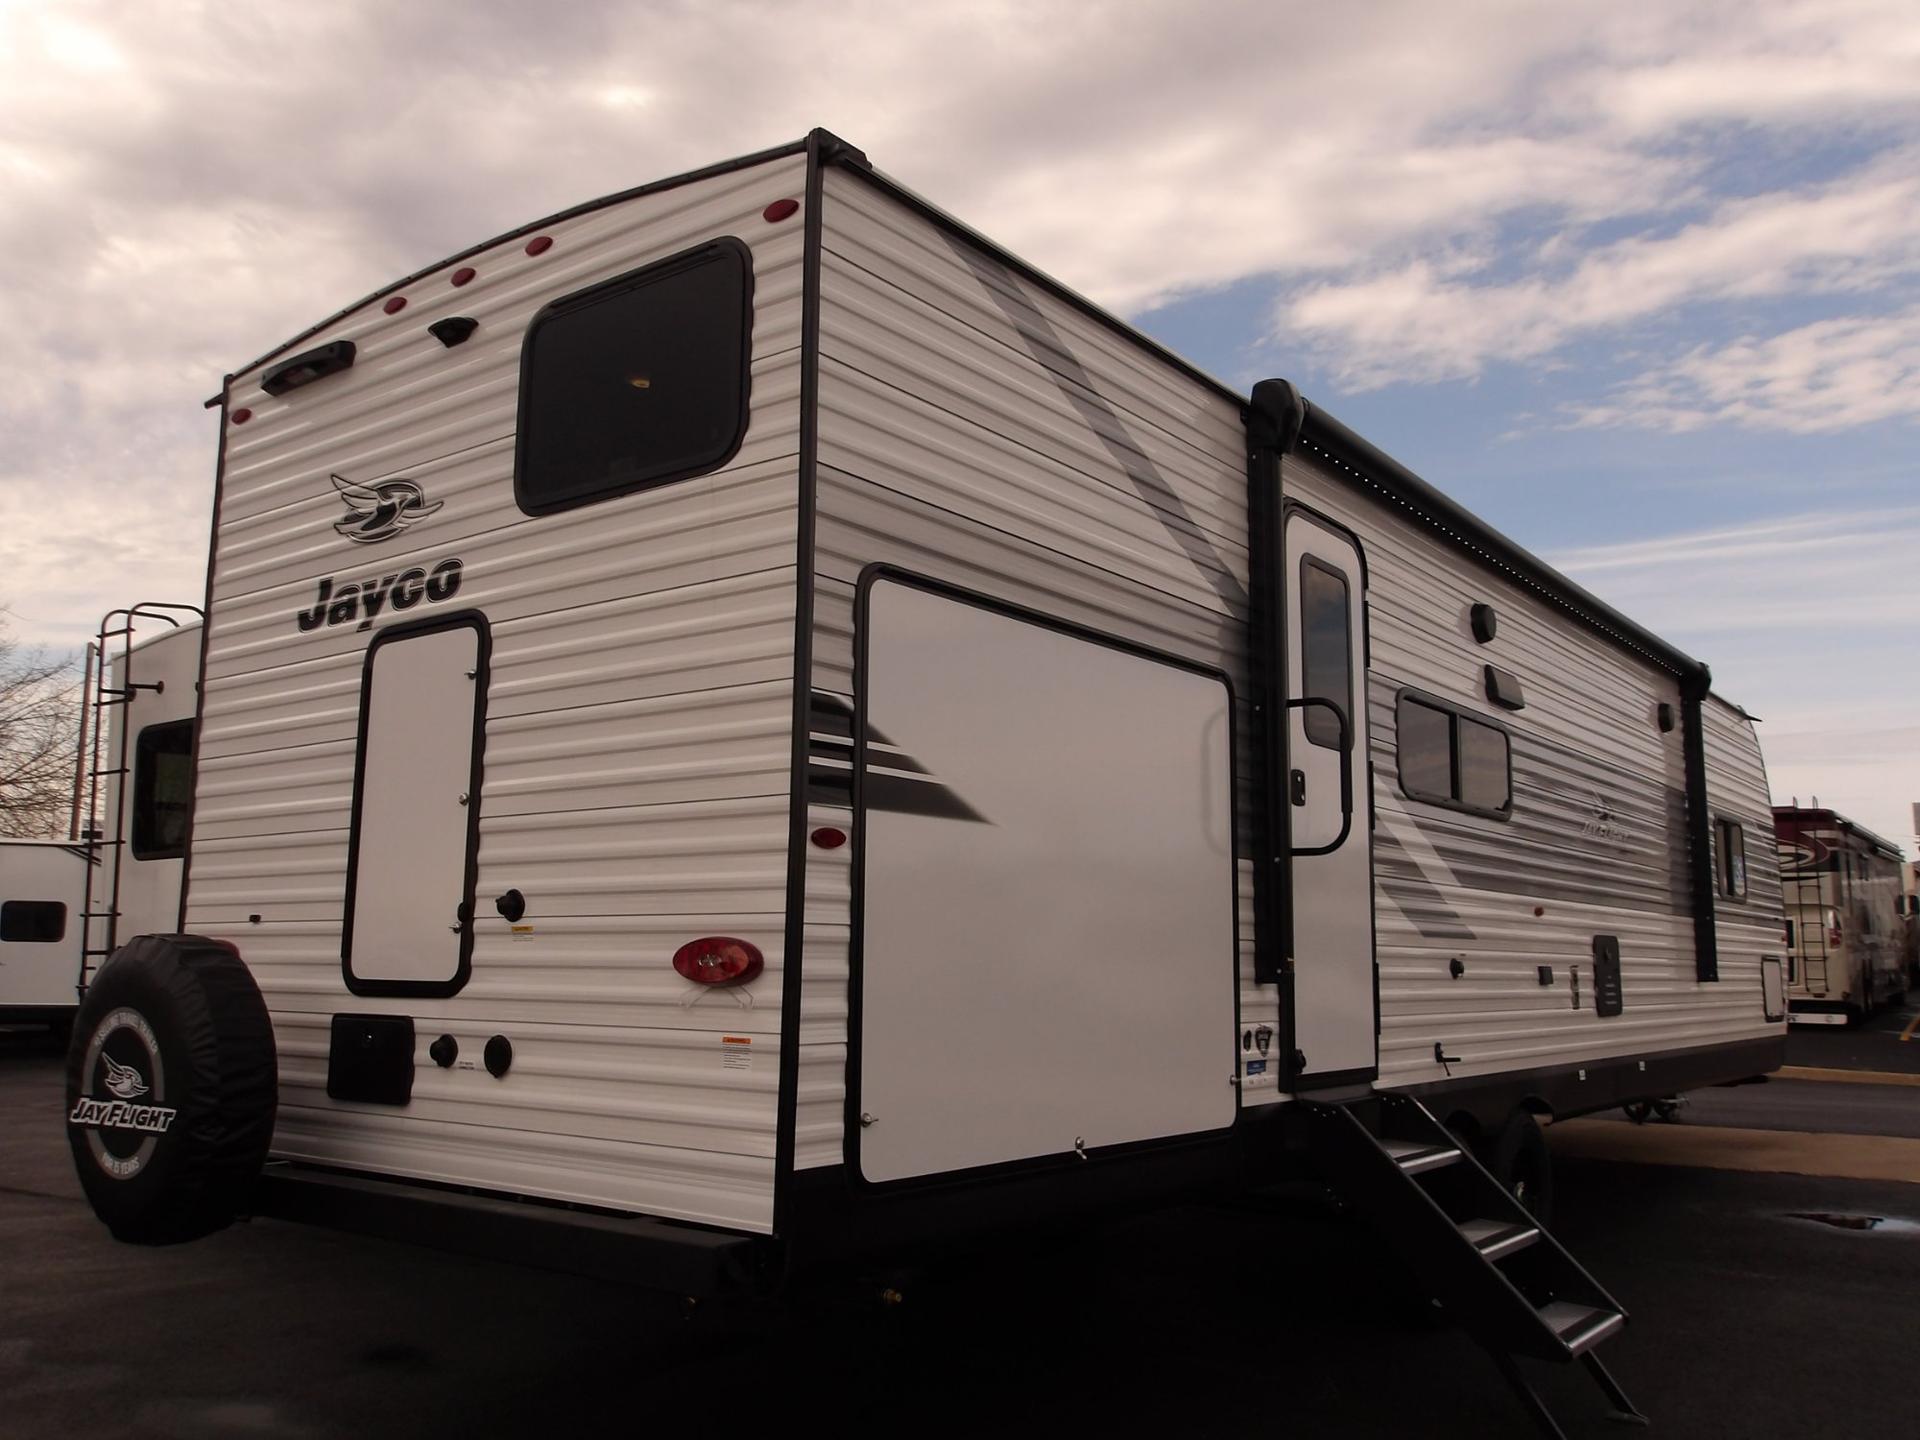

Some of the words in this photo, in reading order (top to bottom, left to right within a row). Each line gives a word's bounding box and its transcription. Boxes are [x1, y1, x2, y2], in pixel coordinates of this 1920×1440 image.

[297, 558, 464, 633] Jayco
[71, 1099, 106, 1124] JAY
[105, 1101, 176, 1132] FLIGHT
